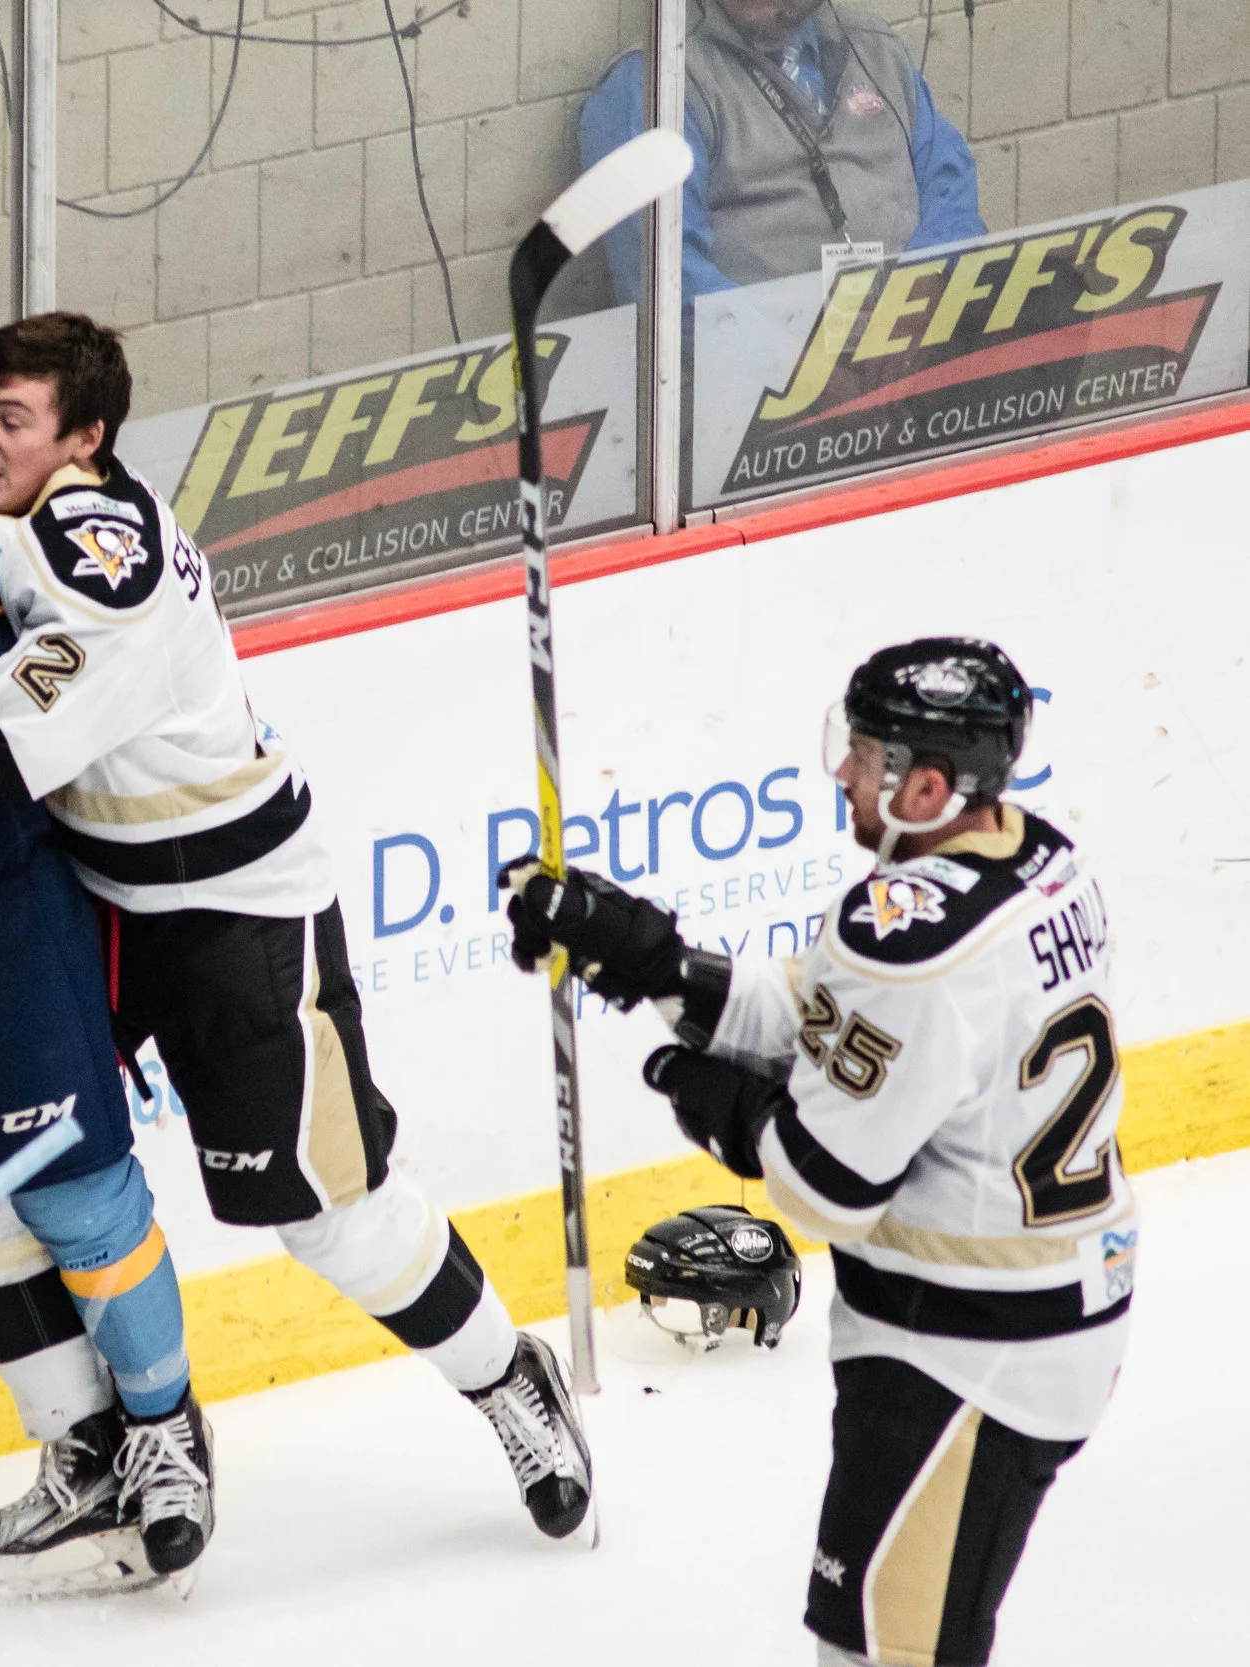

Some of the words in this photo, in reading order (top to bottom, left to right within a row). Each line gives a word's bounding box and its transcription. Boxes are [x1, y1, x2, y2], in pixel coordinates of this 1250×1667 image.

[758, 212, 1176, 421] JEFF'S
[173, 339, 558, 538] JEFF'S
[732, 439, 806, 484] AUTO
[816, 423, 890, 466] BODY
[897, 416, 917, 442] &
[926, 384, 1067, 441] COLLISION
[1074, 360, 1180, 407] CENTER
[213, 560, 268, 598] ODY
[276, 551, 297, 581] &
[307, 518, 449, 575] COLLISION
[458, 488, 563, 538] CENTR
[11, 633, 87, 713] 2
[373, 832, 455, 940] D.
[487, 766, 804, 913] Petros
[413, 931, 511, 984] EVER
[797, 984, 903, 1100] 25
[196, 1146, 274, 1172] CM
[555, 1071, 576, 1173] CCM
[1013, 992, 1123, 1228] 2
[64, 1250, 109, 1270] CCM
